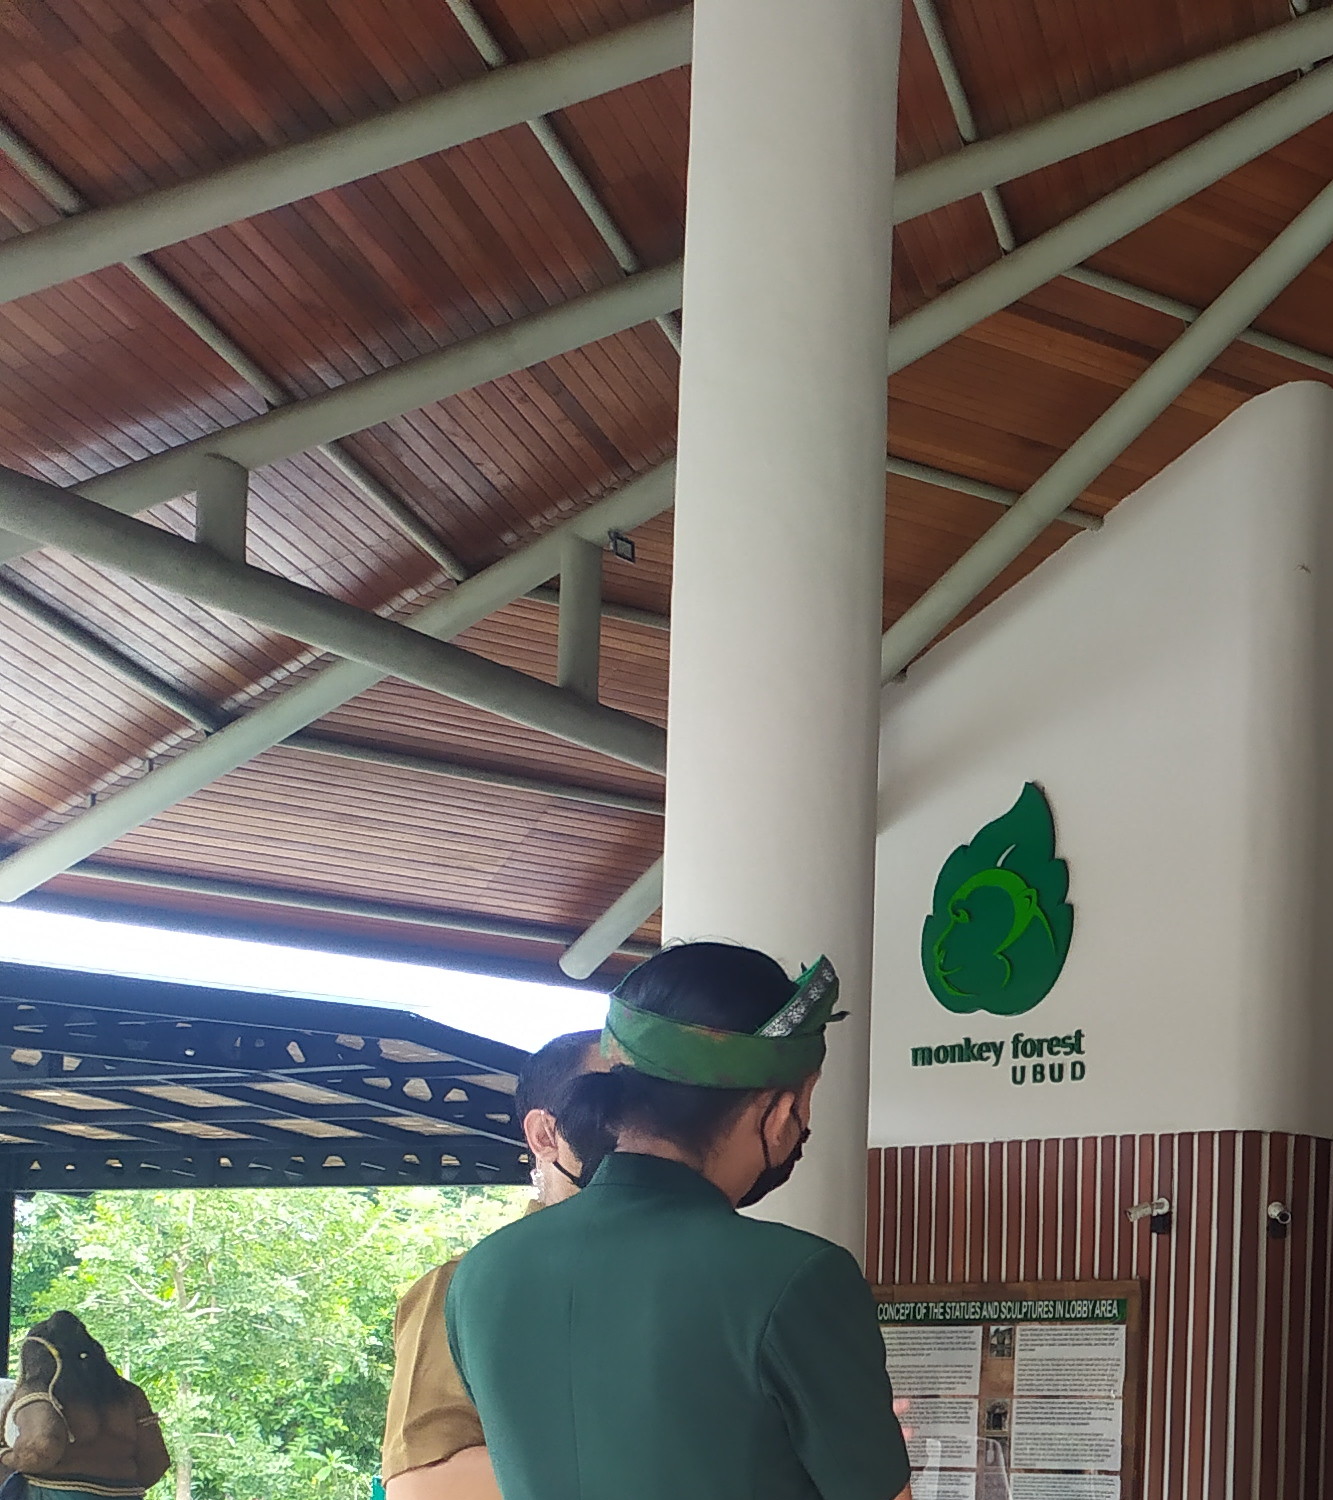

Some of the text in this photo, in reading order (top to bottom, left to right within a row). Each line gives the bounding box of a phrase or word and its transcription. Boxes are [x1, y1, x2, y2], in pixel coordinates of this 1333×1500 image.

[911, 1028, 1086, 1067] monkey forest
[1011, 1060, 1086, 1086] UBUD
[877, 1299, 1119, 1320] CONCEPT OF THE STATUES AND SCULPTURES IN LOBBY AREA
